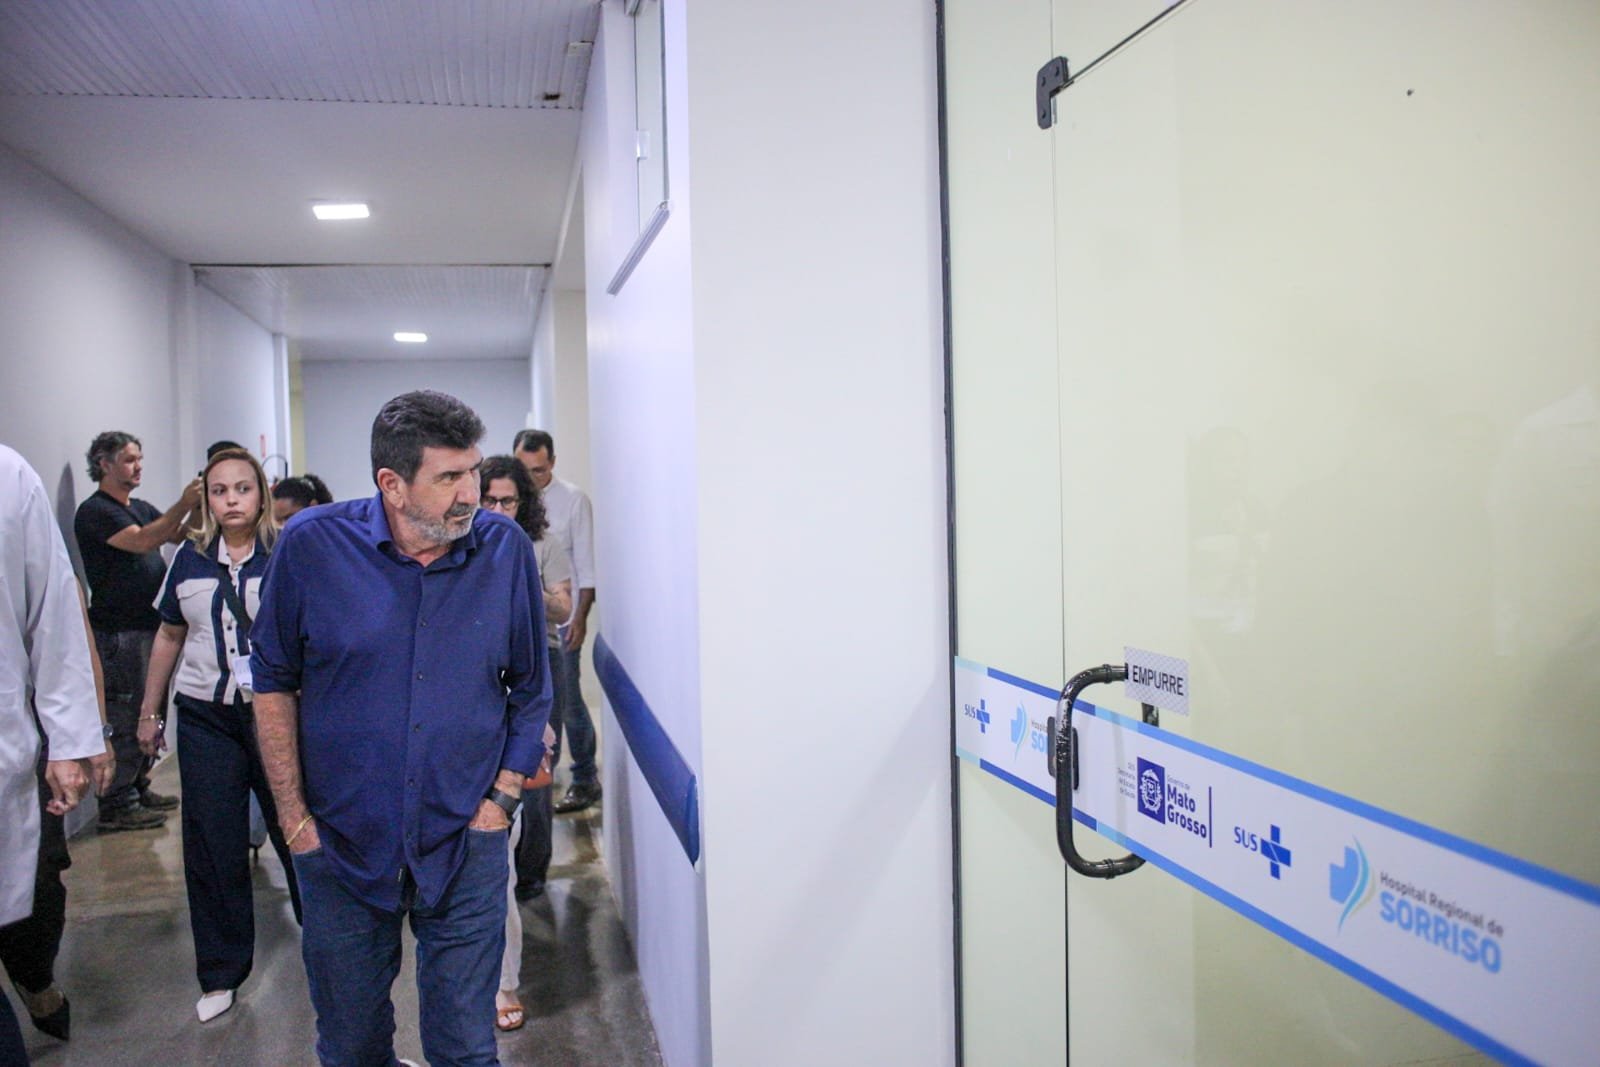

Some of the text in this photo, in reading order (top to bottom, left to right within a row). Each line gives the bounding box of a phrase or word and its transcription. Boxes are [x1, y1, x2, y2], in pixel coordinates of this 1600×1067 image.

[1132, 664, 1184, 696] EMPURRE
[964, 704, 976, 719] SUS
[1167, 783, 1196, 812] Mato
[1167, 804, 1207, 838] Grosso
[1234, 825, 1258, 852] SUS
[1380, 871, 1504, 938] Hospital Regional de
[1380, 890, 1502, 974] SORRISO
